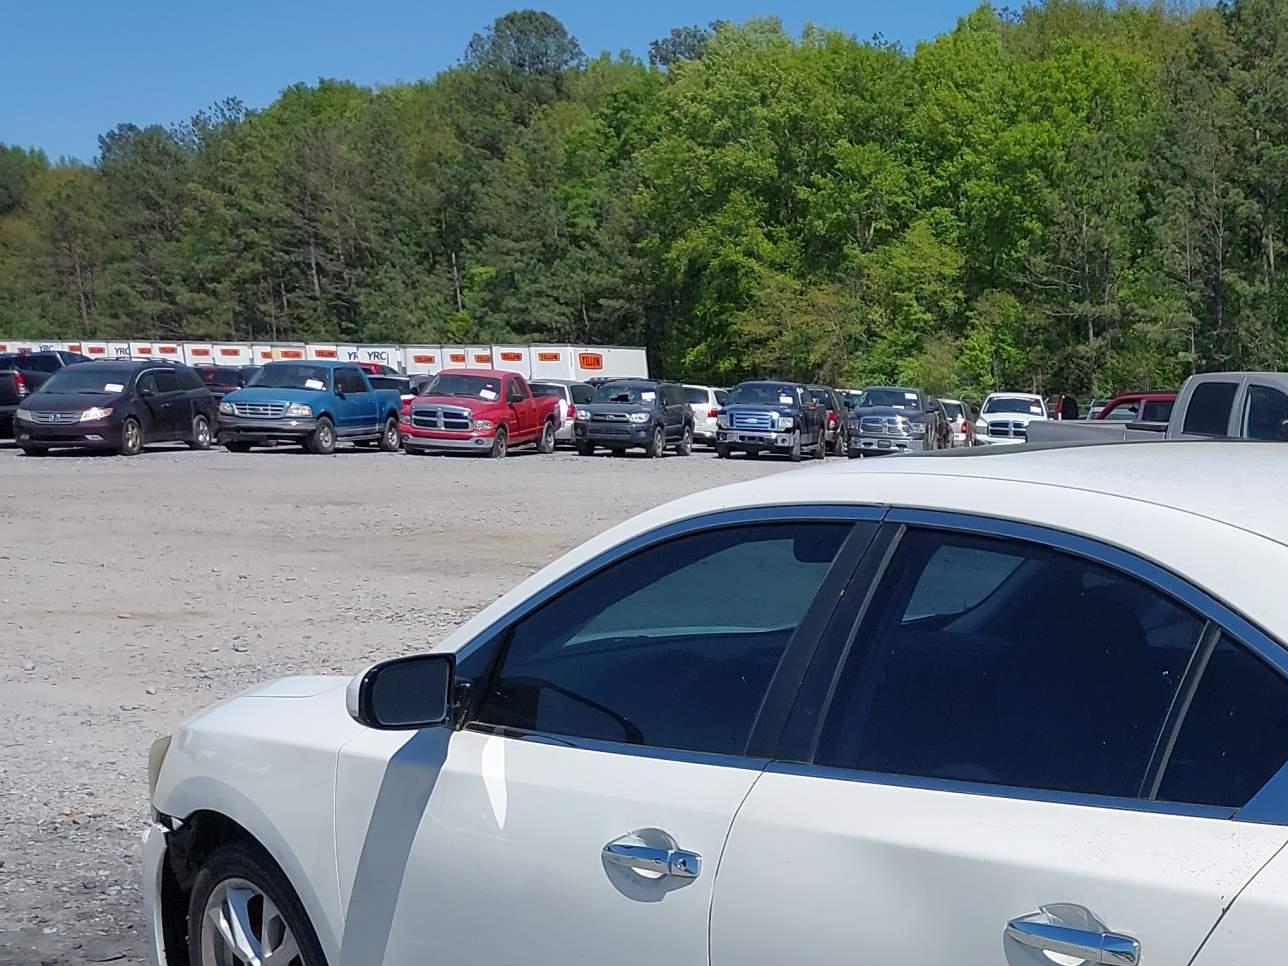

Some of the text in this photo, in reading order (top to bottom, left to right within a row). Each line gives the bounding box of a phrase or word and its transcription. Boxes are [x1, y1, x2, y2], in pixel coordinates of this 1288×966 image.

[114, 346, 130, 355] YRC
[347, 351, 358, 360] YR
[367, 351, 388, 361] YRC
